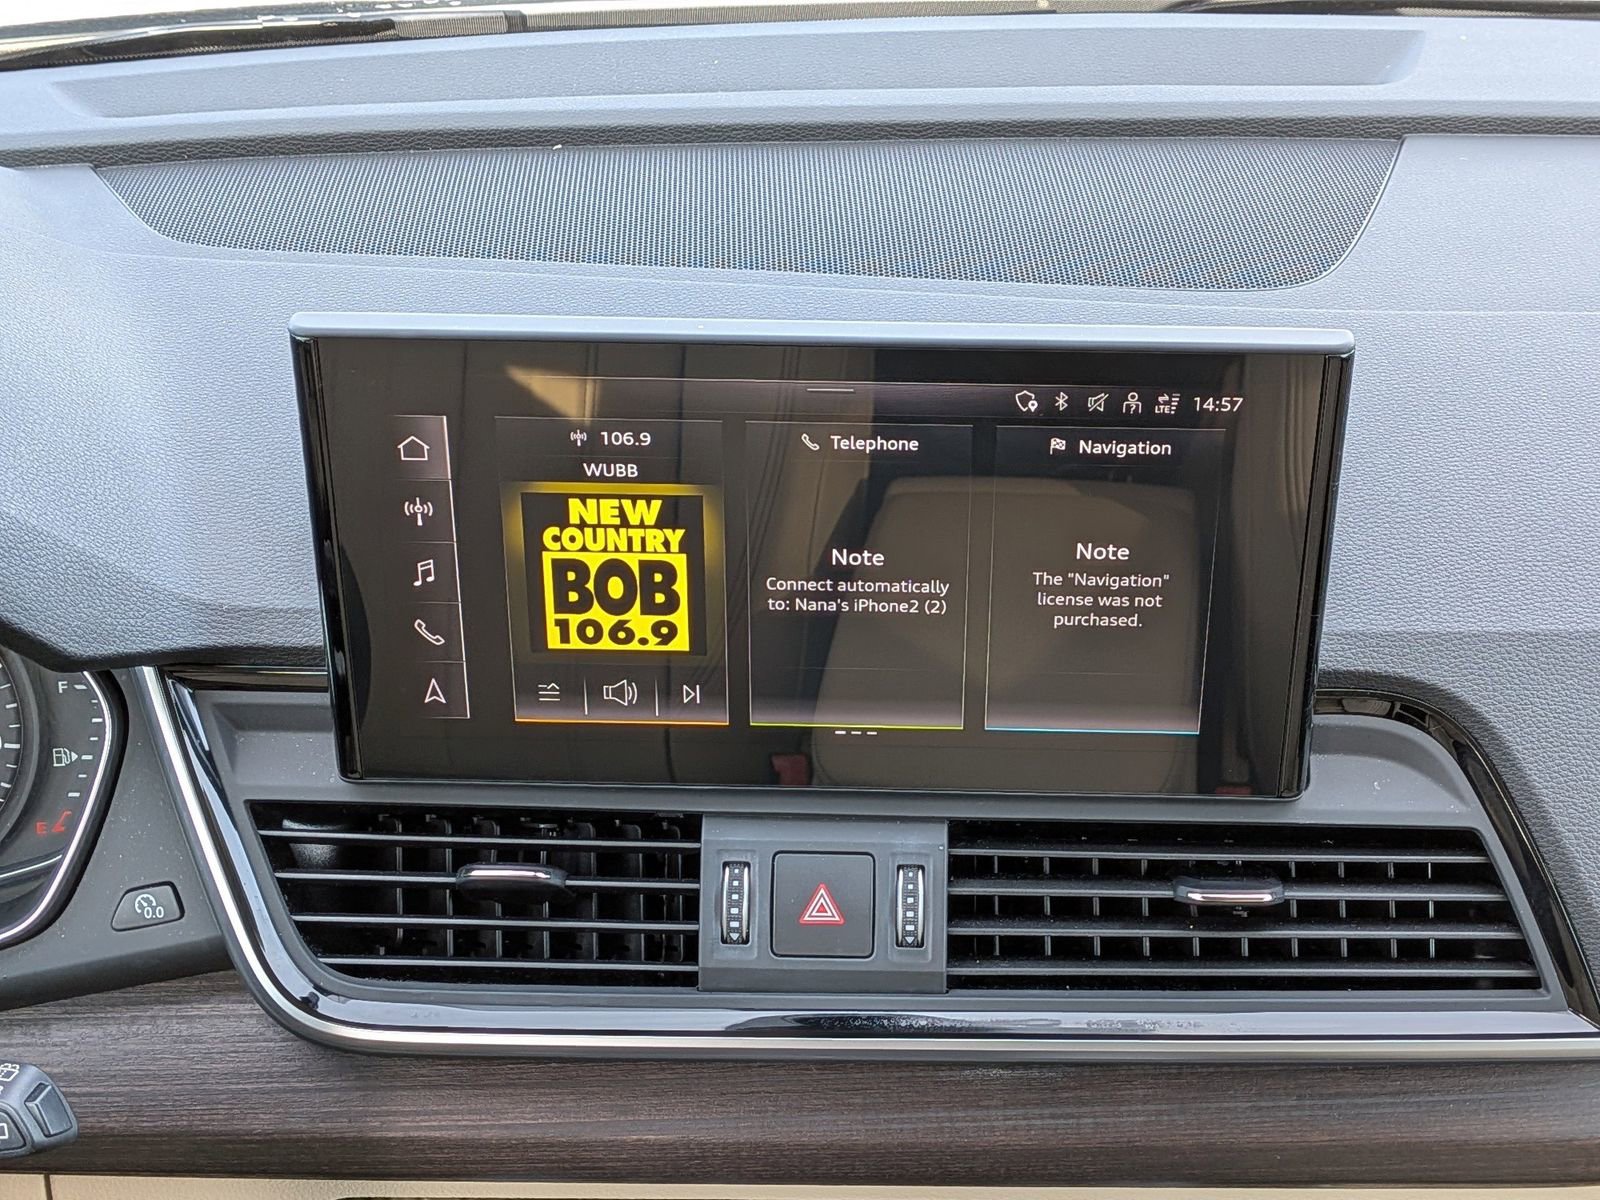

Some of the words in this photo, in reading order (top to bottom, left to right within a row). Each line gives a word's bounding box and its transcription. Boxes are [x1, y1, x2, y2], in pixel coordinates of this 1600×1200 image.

[1155, 404, 1170, 414] LTE
[1193, 396, 1243, 413] 14:57
[600, 431, 651, 447] 106.9
[830, 435, 919, 453] Telephone
[1078, 439, 1172, 457] Navigation
[583, 462, 639, 478] WUBB
[567, 498, 662, 526] NEW
[542, 527, 685, 553] COUNTRY
[831, 548, 885, 567] Note
[1075, 542, 1130, 561] Note
[551, 558, 681, 617] BOB
[766, 577, 834, 594] Connect
[837, 578, 950, 597] automatically
[1033, 571, 1063, 587] The
[1067, 572, 1170, 592] "Navigation"
[767, 597, 790, 613] to:
[795, 597, 850, 614] Nana's
[854, 598, 919, 614] iPhone2
[924, 599, 948, 616] (2)
[1037, 591, 1094, 608] license
[1097, 595, 1130, 608] was
[1134, 593, 1163, 609] not
[1053, 611, 1143, 630] purchased.
[554, 619, 679, 647] 106.9
[57, 680, 68, 693] F
[36, 822, 48, 834] E
[143, 906, 165, 919] 0.0
